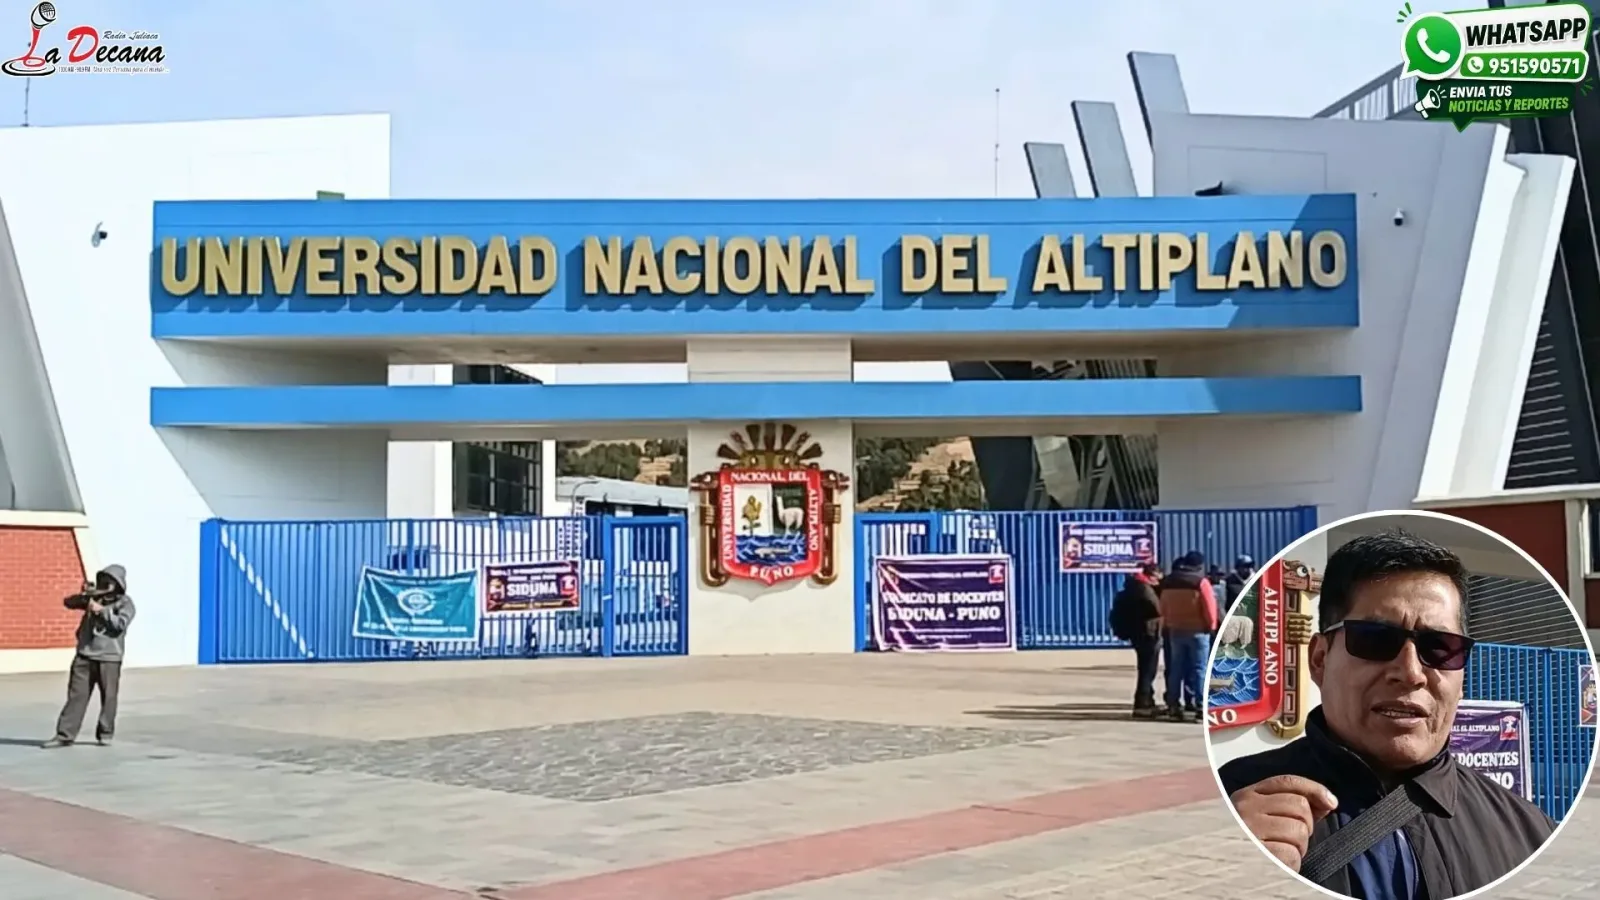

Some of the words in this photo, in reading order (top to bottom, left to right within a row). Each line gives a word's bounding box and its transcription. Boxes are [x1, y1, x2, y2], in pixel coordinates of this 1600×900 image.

[161, 235, 557, 296] UNIVERSIDAD
[583, 234, 875, 296] NACIONAL
[901, 233, 1007, 294] DEL
[1032, 230, 1347, 293] ALTIPLANO
[731, 471, 786, 482] NACIONAL
[788, 471, 809, 481] DEL
[722, 484, 733, 560] UNIVERSIDAD
[808, 488, 819, 551] ALTIPLANO
[1084, 543, 1134, 556] SIDUNA
[750, 566, 794, 581] PUNO
[506, 582, 558, 597] SIDUNA
[937, 592, 953, 604] DE
[953, 591, 1004, 604] DOCENTES
[957, 606, 1001, 621] PUNO
[1264, 586, 1279, 685] ALTIPLANO
[1457, 751, 1519, 768] DOCENTES
[1484, 772, 1514, 790] NO
